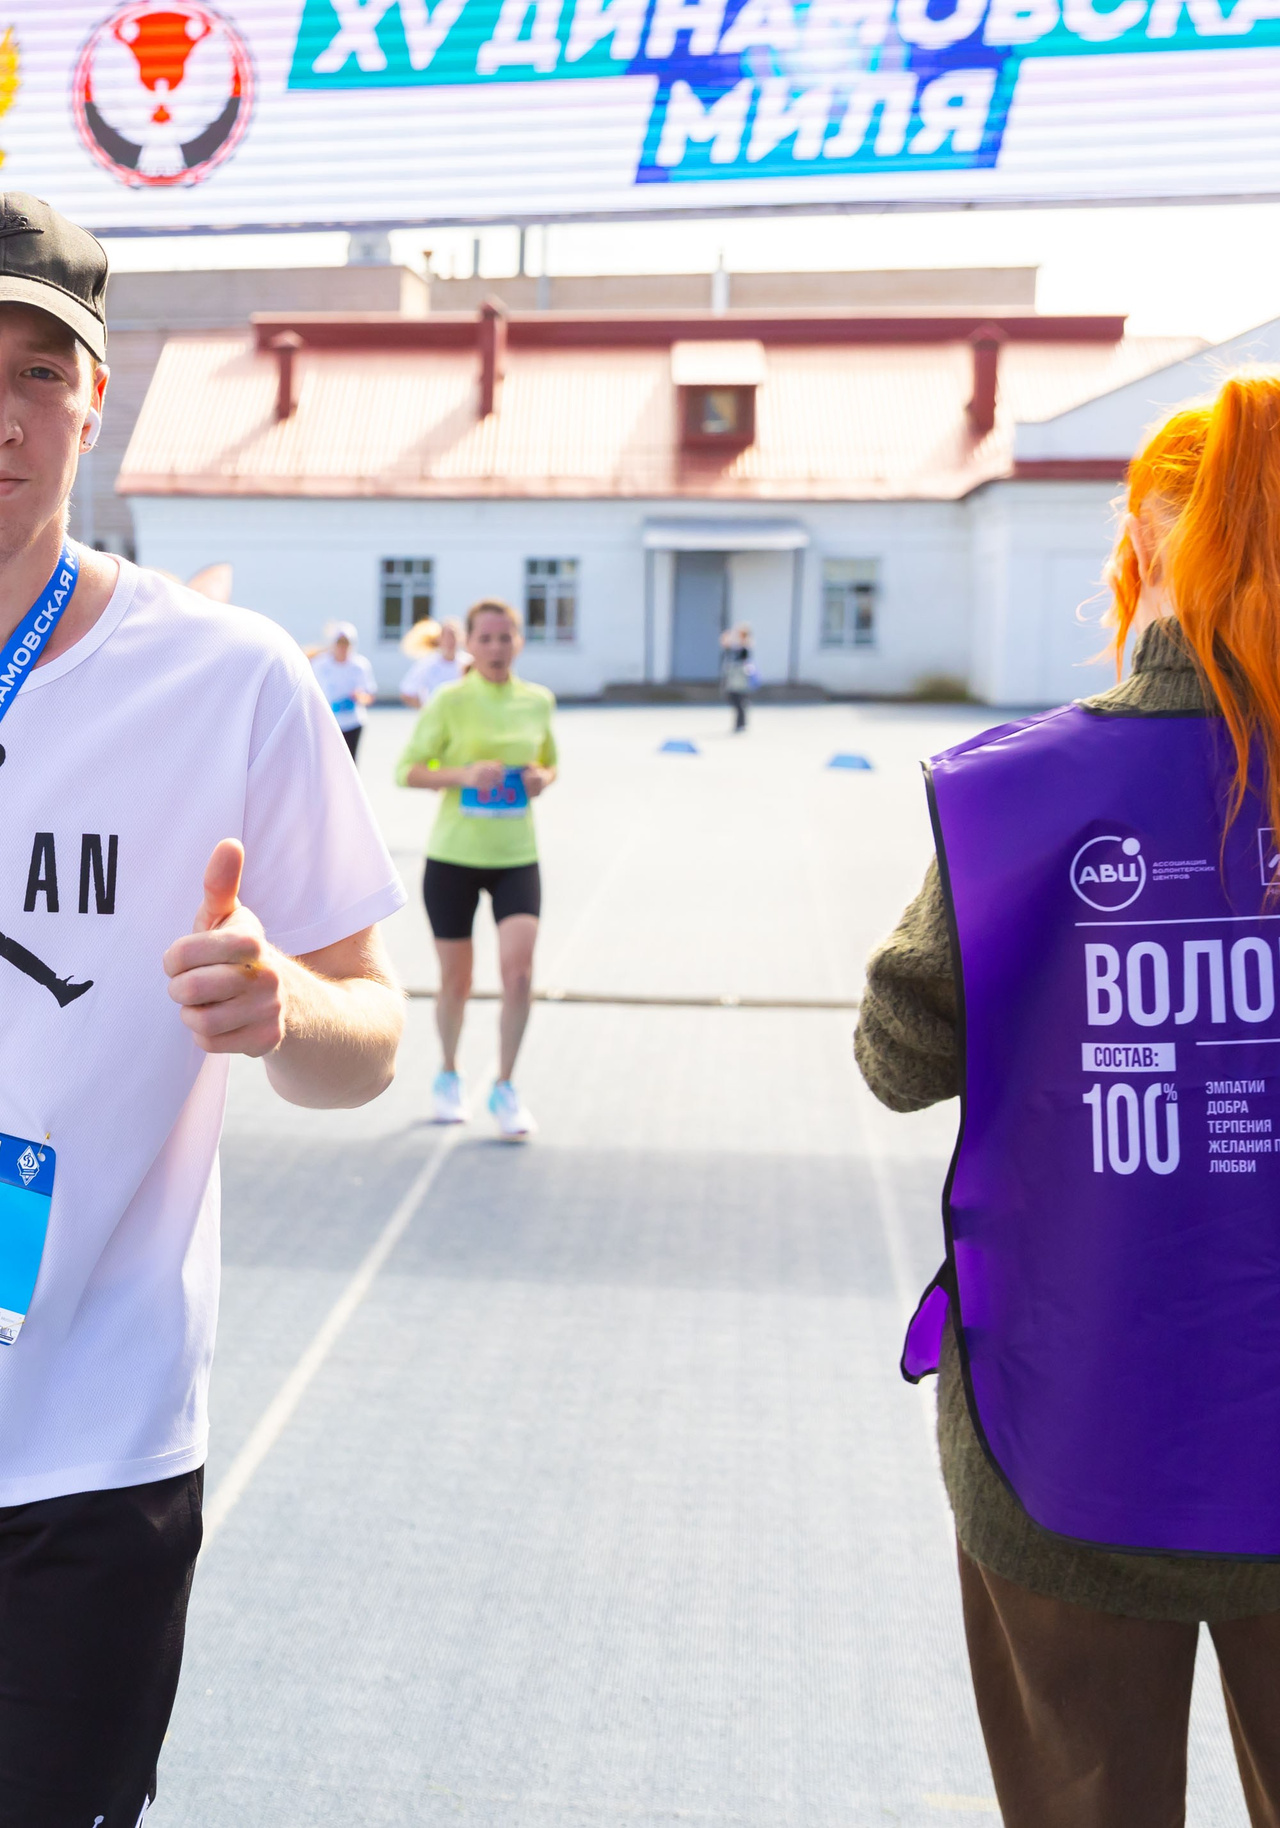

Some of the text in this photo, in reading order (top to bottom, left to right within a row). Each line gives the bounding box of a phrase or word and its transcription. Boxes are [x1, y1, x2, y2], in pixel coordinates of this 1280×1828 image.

[475, 0, 1280, 75] ДИНАМОВС
[655, 67, 998, 167] МИЛЯ
[1078, 863, 1139, 885] АВЦ
[1084, 936, 1280, 1027] ВОЛО
[1094, 1046, 1160, 1068] СОСТАВ:
[1205, 1080, 1266, 1095] ЭМПАТИИ
[1206, 1100, 1249, 1115] ДОБРА
[1207, 1119, 1272, 1134] ТЕРПЕНИЯ
[1208, 1139, 1272, 1153] ЖЕЛАНИЯ
[1209, 1159, 1257, 1173] ЛЮБВИ
